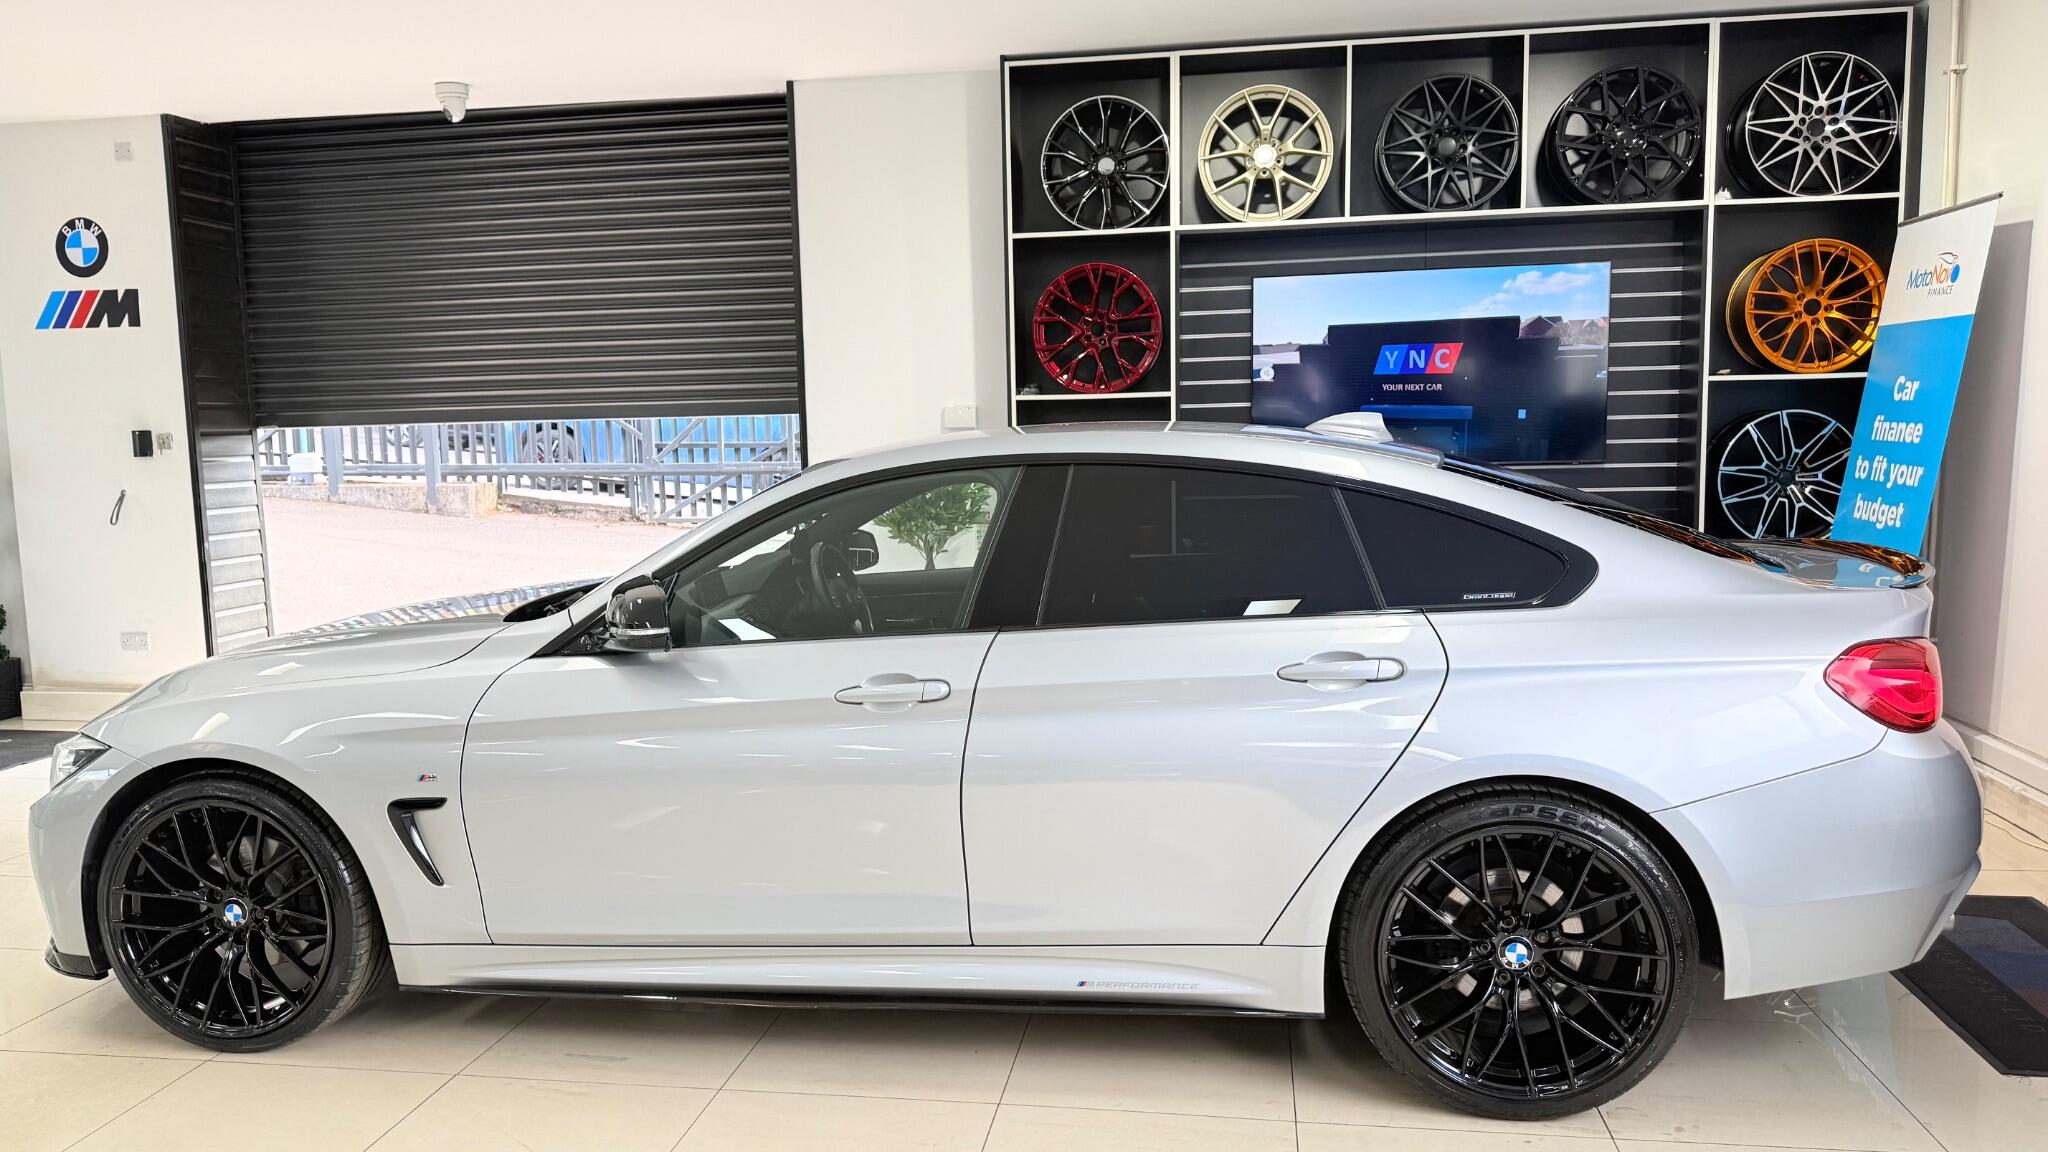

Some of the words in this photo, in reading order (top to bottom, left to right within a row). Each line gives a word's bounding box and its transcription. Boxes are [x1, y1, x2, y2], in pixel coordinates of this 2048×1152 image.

[61, 219, 102, 237] BMW
[1927, 284, 1954, 297] FINANCE
[1384, 348, 1450, 369] YNC
[1382, 383, 1404, 392] YOUR
[1404, 383, 1424, 392] NEXT
[1426, 383, 1443, 391] CAR
[1893, 375, 1920, 401] Car
[1871, 415, 1924, 444] finance
[1854, 455, 1869, 480] to
[1870, 455, 1888, 482] fit
[1886, 462, 1924, 489] your
[1853, 493, 1904, 529] budget
[1096, 981, 1200, 990] PERFORMANCE
